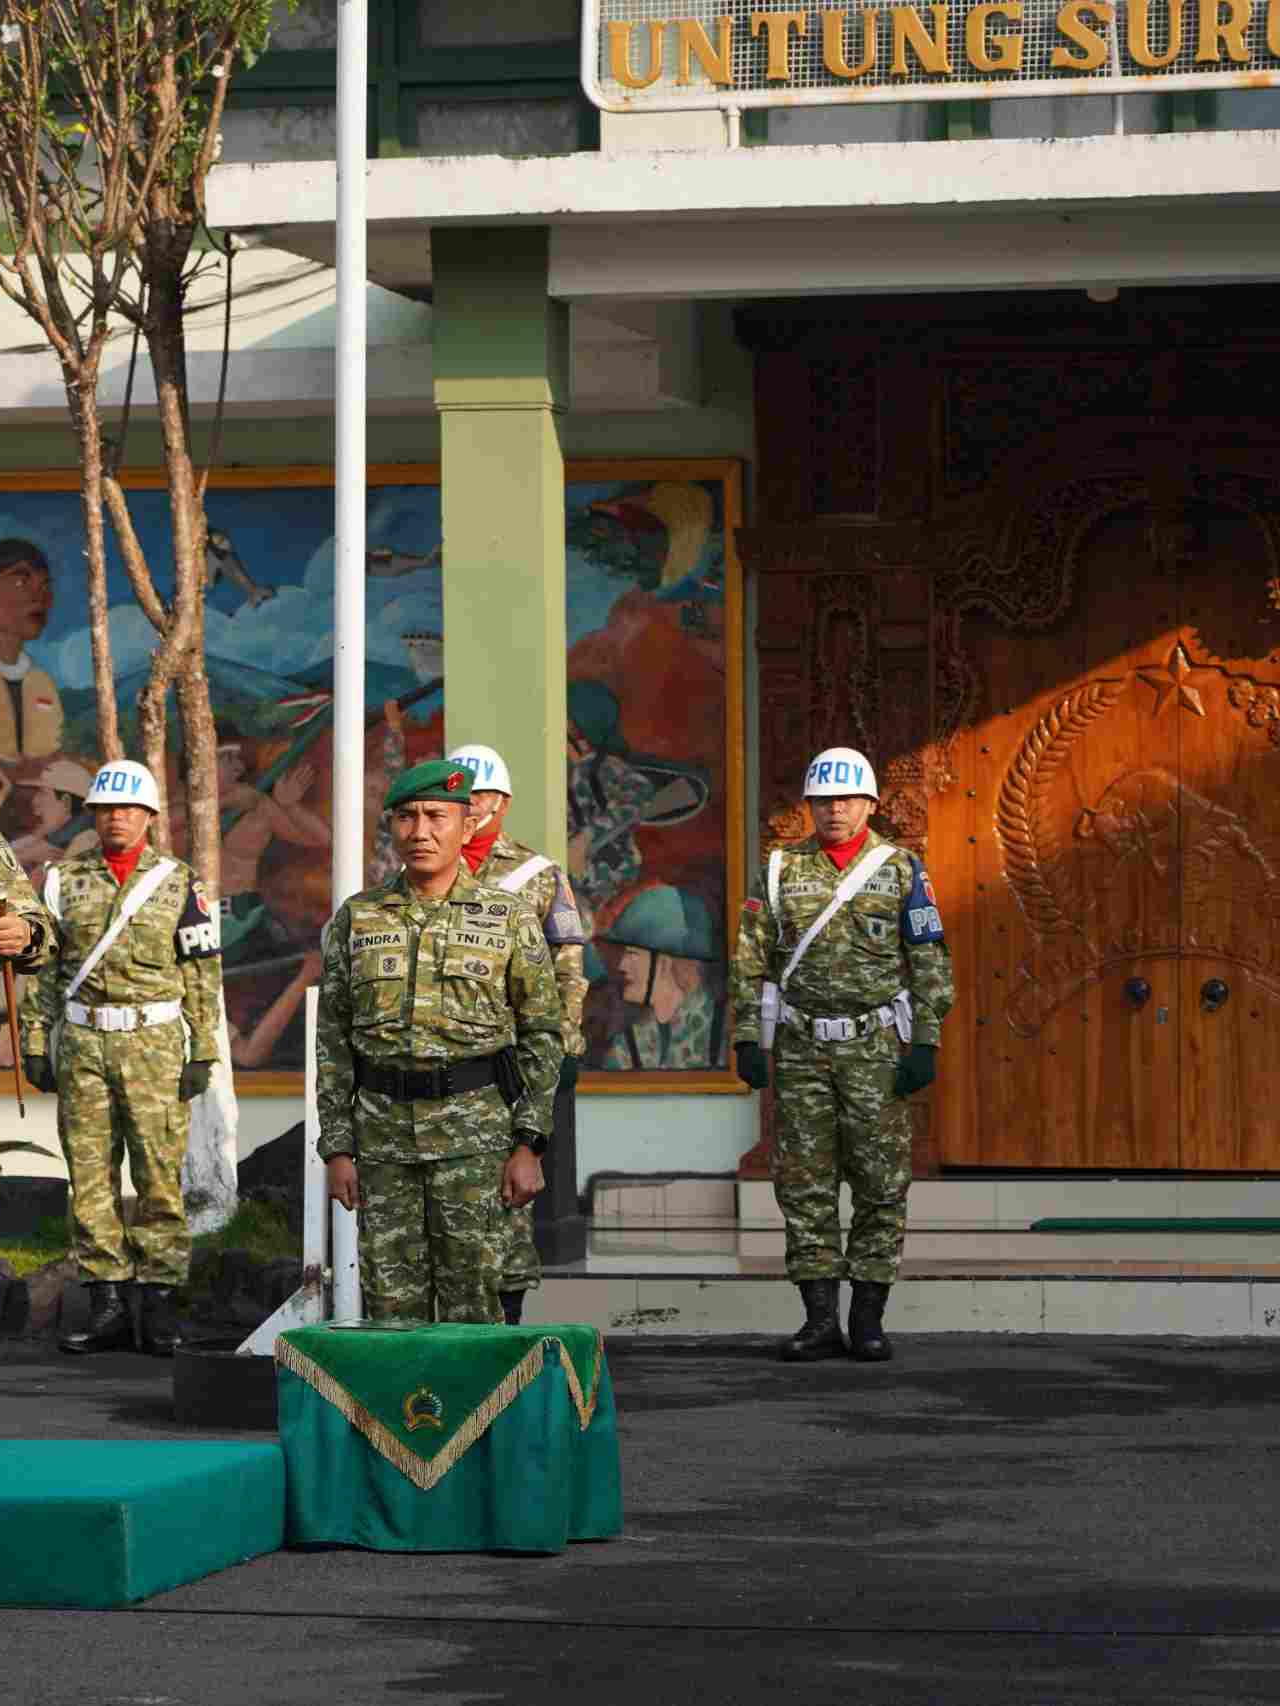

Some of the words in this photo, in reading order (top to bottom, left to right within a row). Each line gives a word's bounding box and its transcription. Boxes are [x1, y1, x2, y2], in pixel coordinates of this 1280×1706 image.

[608, 3, 1024, 89] UNTUNG
[1051, 0, 1280, 70] SUR
[352, 933, 401, 951] HENDRA
[455, 932, 480, 945] TNI
[485, 937, 507, 950] AD
